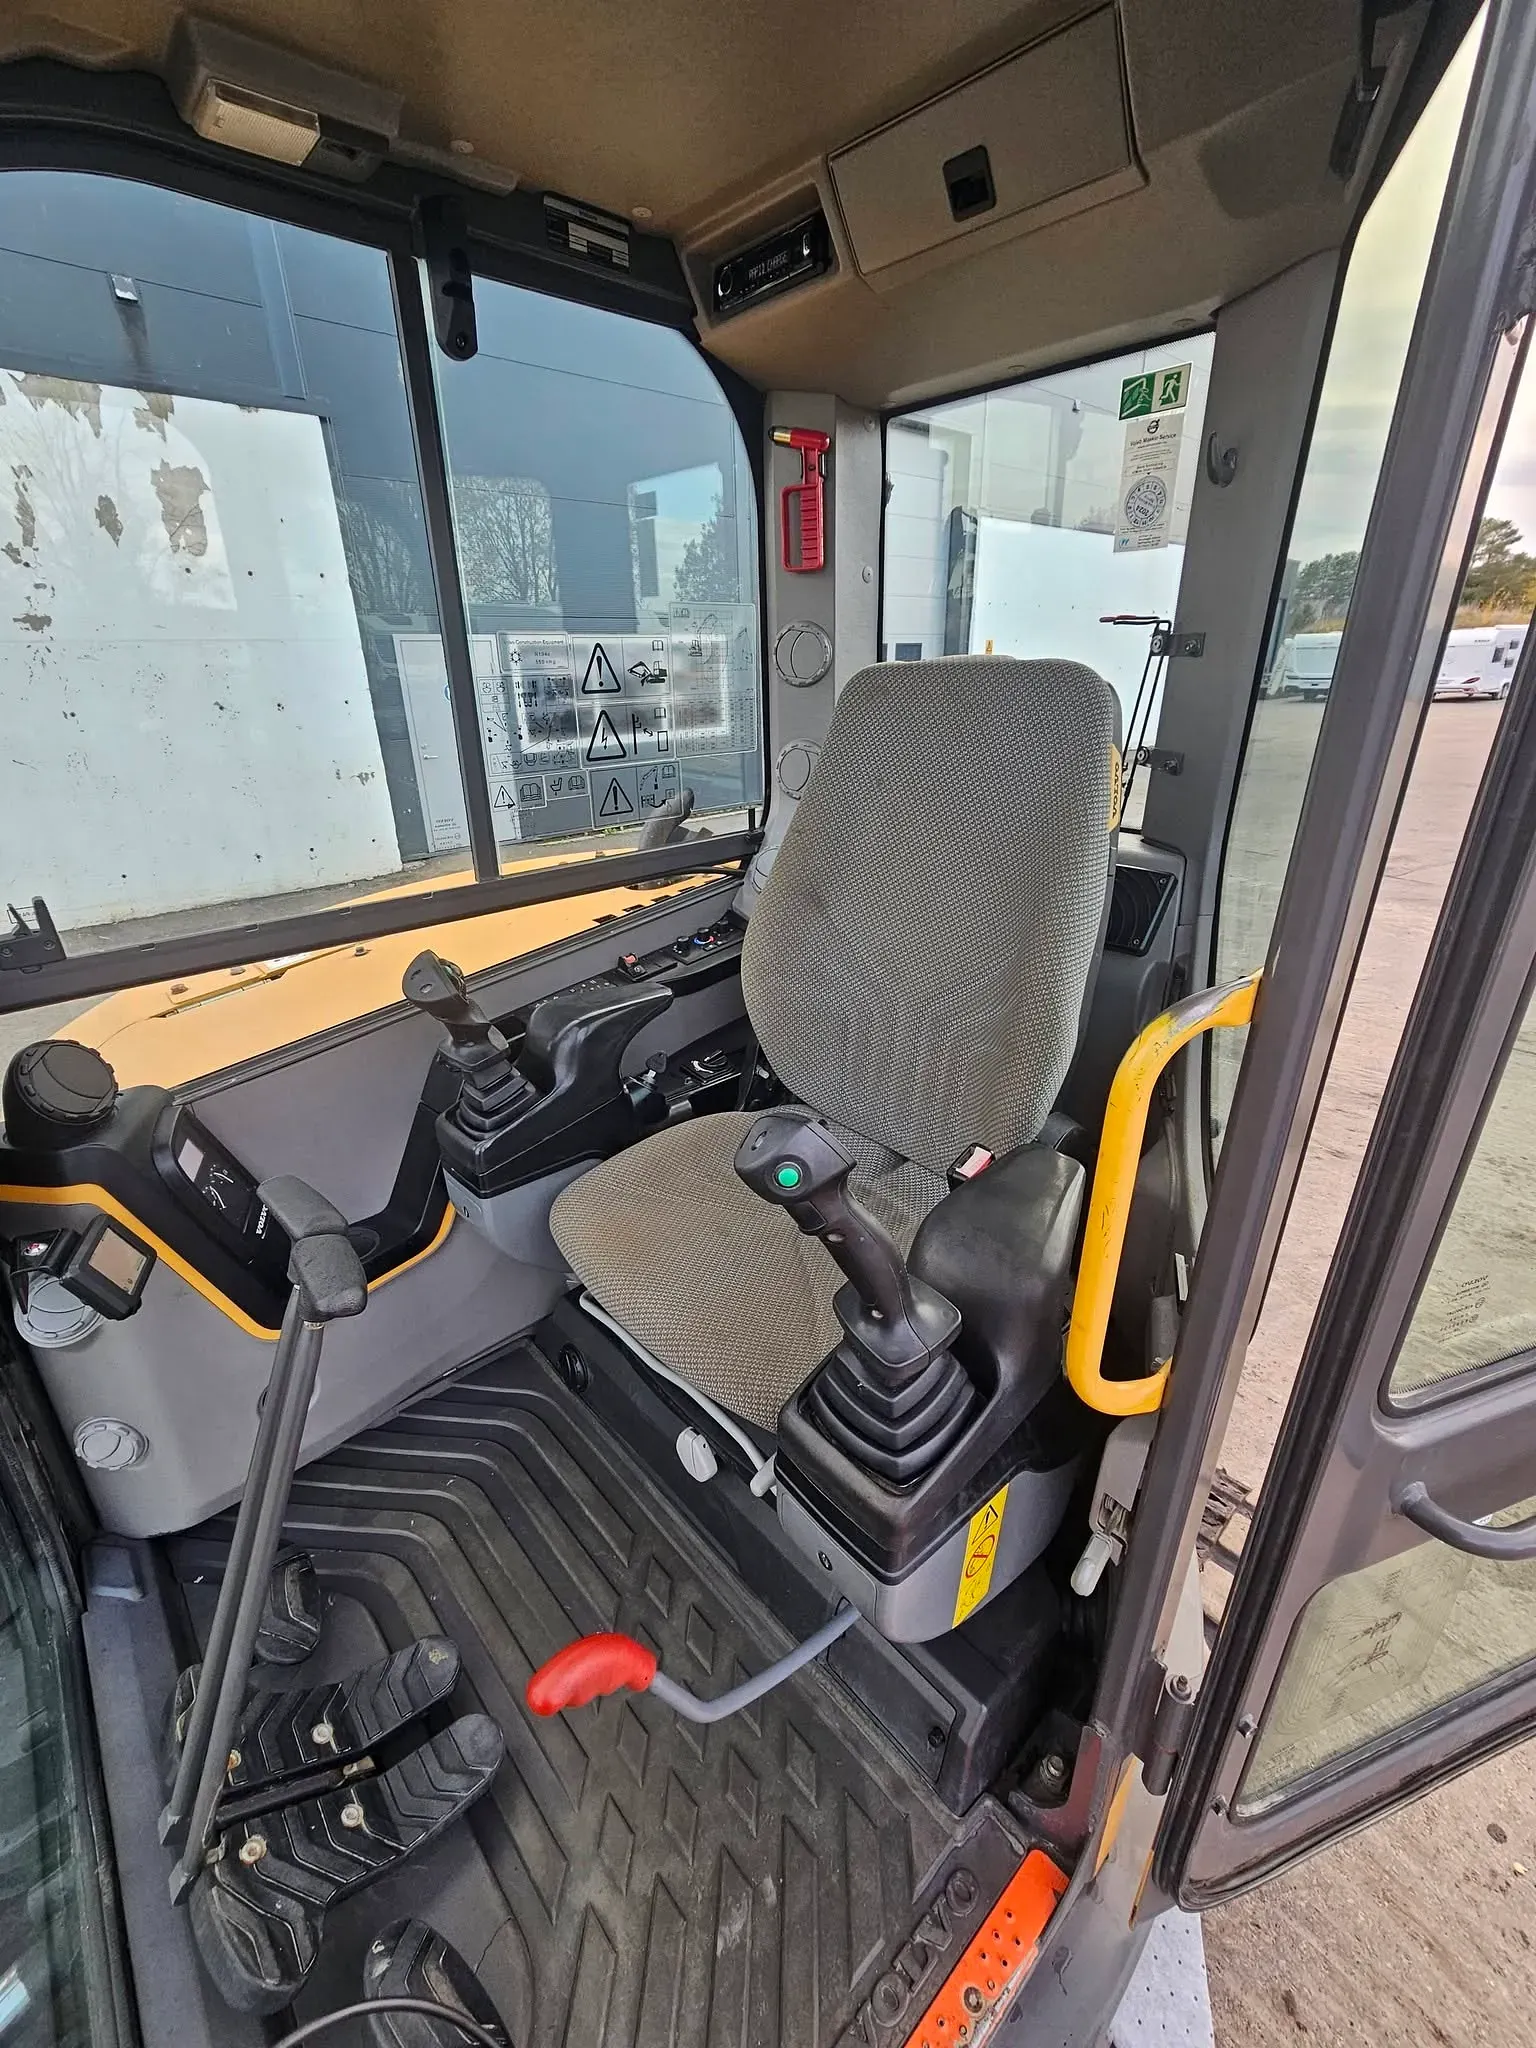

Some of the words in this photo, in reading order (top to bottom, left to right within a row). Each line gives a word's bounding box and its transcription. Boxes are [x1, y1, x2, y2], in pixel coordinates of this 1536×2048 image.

[1135, 504, 1150, 517] 2024
[255, 1203, 269, 1235] VOLV
[850, 1867, 981, 2048] VOLVO
